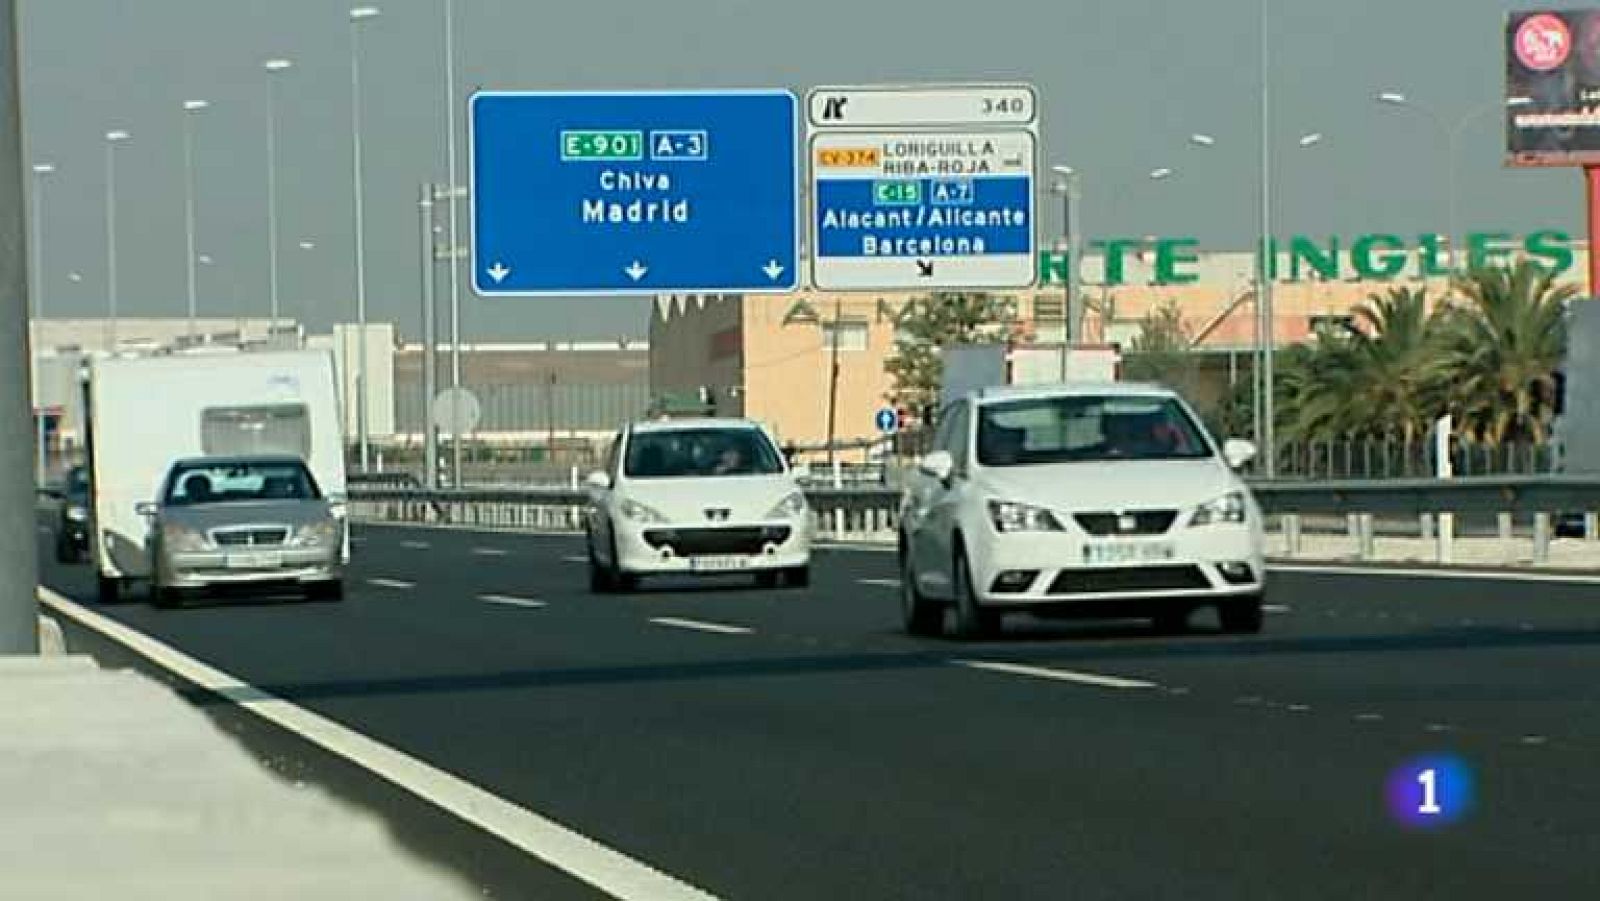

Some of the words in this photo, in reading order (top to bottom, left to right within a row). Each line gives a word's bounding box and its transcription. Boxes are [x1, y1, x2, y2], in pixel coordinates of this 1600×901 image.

[981, 98, 1024, 113] 340
[566, 136, 638, 155] E-901
[657, 136, 702, 155] A-3
[883, 141, 995, 157] LORIGUILLA
[883, 160, 990, 174] RIBA-ROJA
[600, 170, 670, 190] Chiva
[878, 184, 916, 199] E-15
[936, 184, 969, 200] A-7
[582, 199, 688, 223] Madrid
[862, 235, 985, 255] Barcelona
